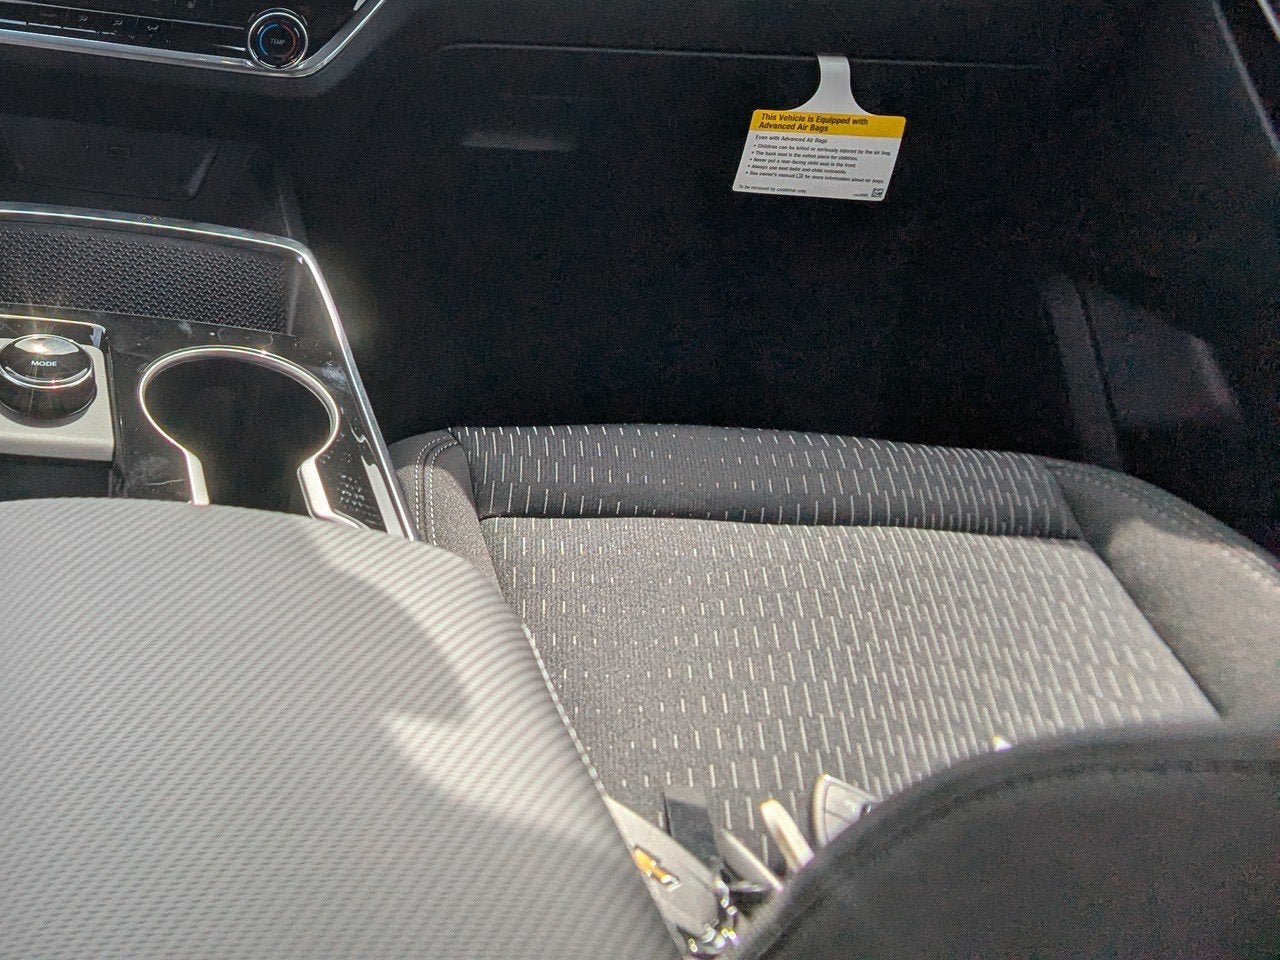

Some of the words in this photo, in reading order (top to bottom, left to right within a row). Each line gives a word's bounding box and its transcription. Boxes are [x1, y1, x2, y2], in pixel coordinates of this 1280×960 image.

[270, 38, 286, 46] TEMP
[780, 114, 806, 122] Vehicle
[816, 116, 850, 125] Equipped
[759, 122, 796, 130] Advanced
[810, 124, 829, 132] Bags
